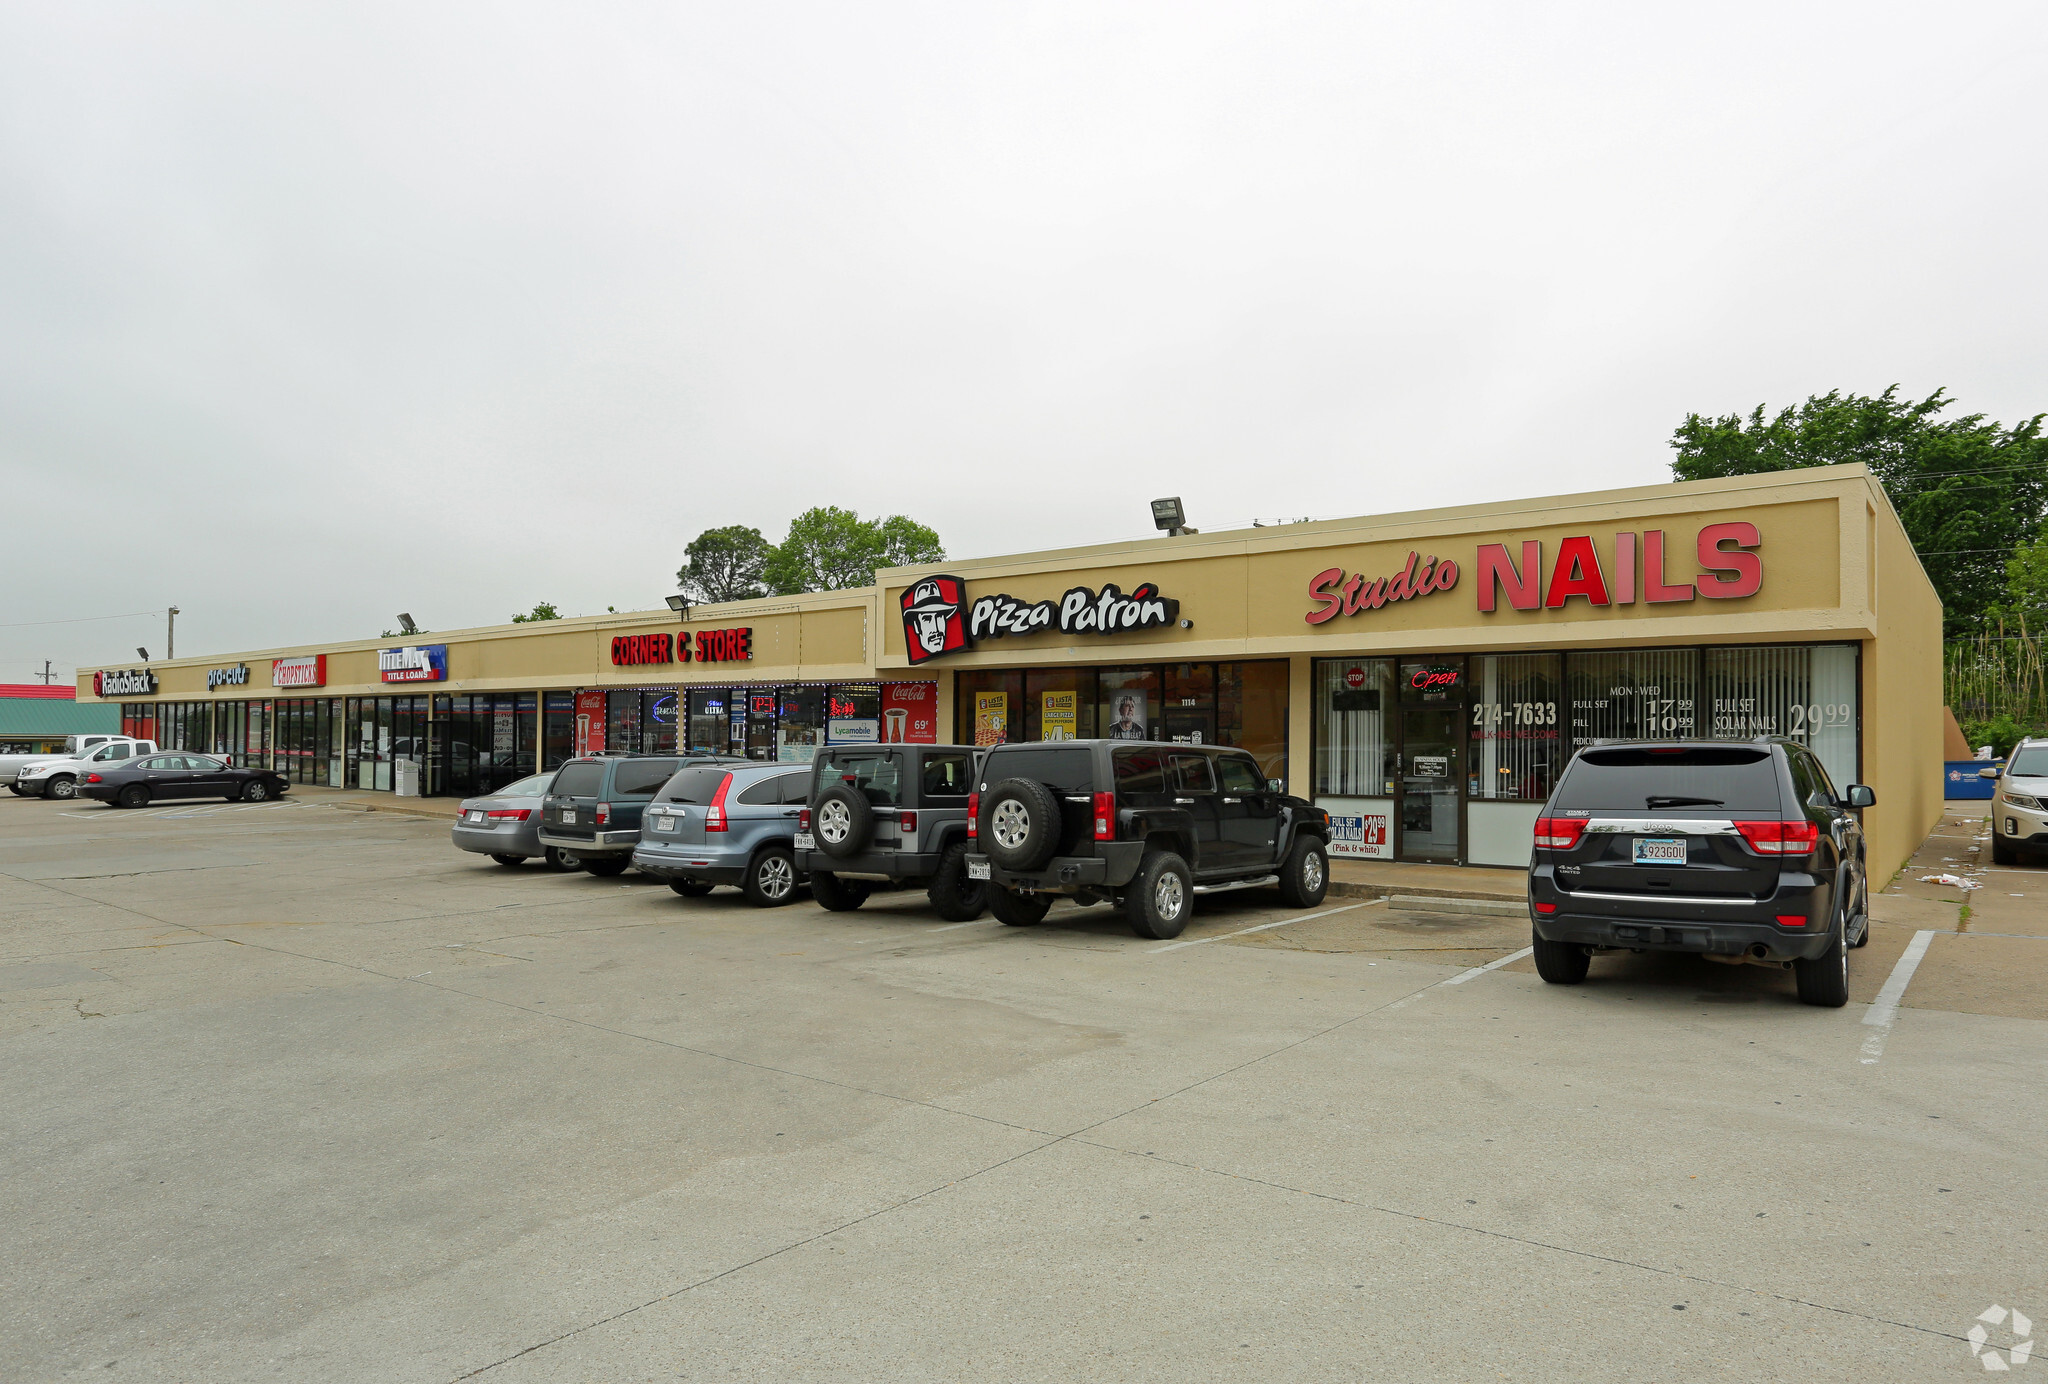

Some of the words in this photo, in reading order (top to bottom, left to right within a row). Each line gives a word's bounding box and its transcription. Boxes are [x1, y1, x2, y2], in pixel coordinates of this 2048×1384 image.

[1305, 551, 1459, 625] Studio
[1476, 521, 1763, 613] NAILS
[971, 598, 1049, 636] Pizza
[1061, 587, 1165, 631] Patrón
[611, 633, 669, 666] CORNER
[677, 631, 688, 662] C
[695, 627, 748, 662] STORE
[207, 664, 246, 691] pro-cuts
[278, 664, 317, 685] CHOPSTICKS
[387, 672, 405, 680] TITLE
[406, 671, 428, 679] LOANS
[1348, 674, 1364, 682] STOP
[1412, 671, 1457, 689] Open
[102, 670, 150, 694] RadioShack
[1610, 687, 1633, 696] MON
[1640, 686, 1661, 696] WED
[1573, 700, 1593, 708] FULL
[1595, 700, 1609, 708] SET
[1715, 699, 1737, 713] FULL
[1739, 699, 1755, 712] SET
[1473, 702, 1557, 726] 274-7633
[1573, 719, 1589, 727] FILL
[1714, 716, 1746, 730] SOLAR
[1749, 716, 1777, 730] NAILS
[835, 727, 870, 735] Lycamobile
[1471, 730, 1512, 739] WALK-INS
[1515, 730, 1559, 739] WELCOME
[1332, 817, 1345, 827] FULL
[1346, 818, 1356, 827] SET
[1642, 821, 1673, 832] Jeep
[1346, 827, 1361, 840] NAILS
[1333, 843, 1349, 853] (Pink
[1359, 845, 1380, 855] white)
